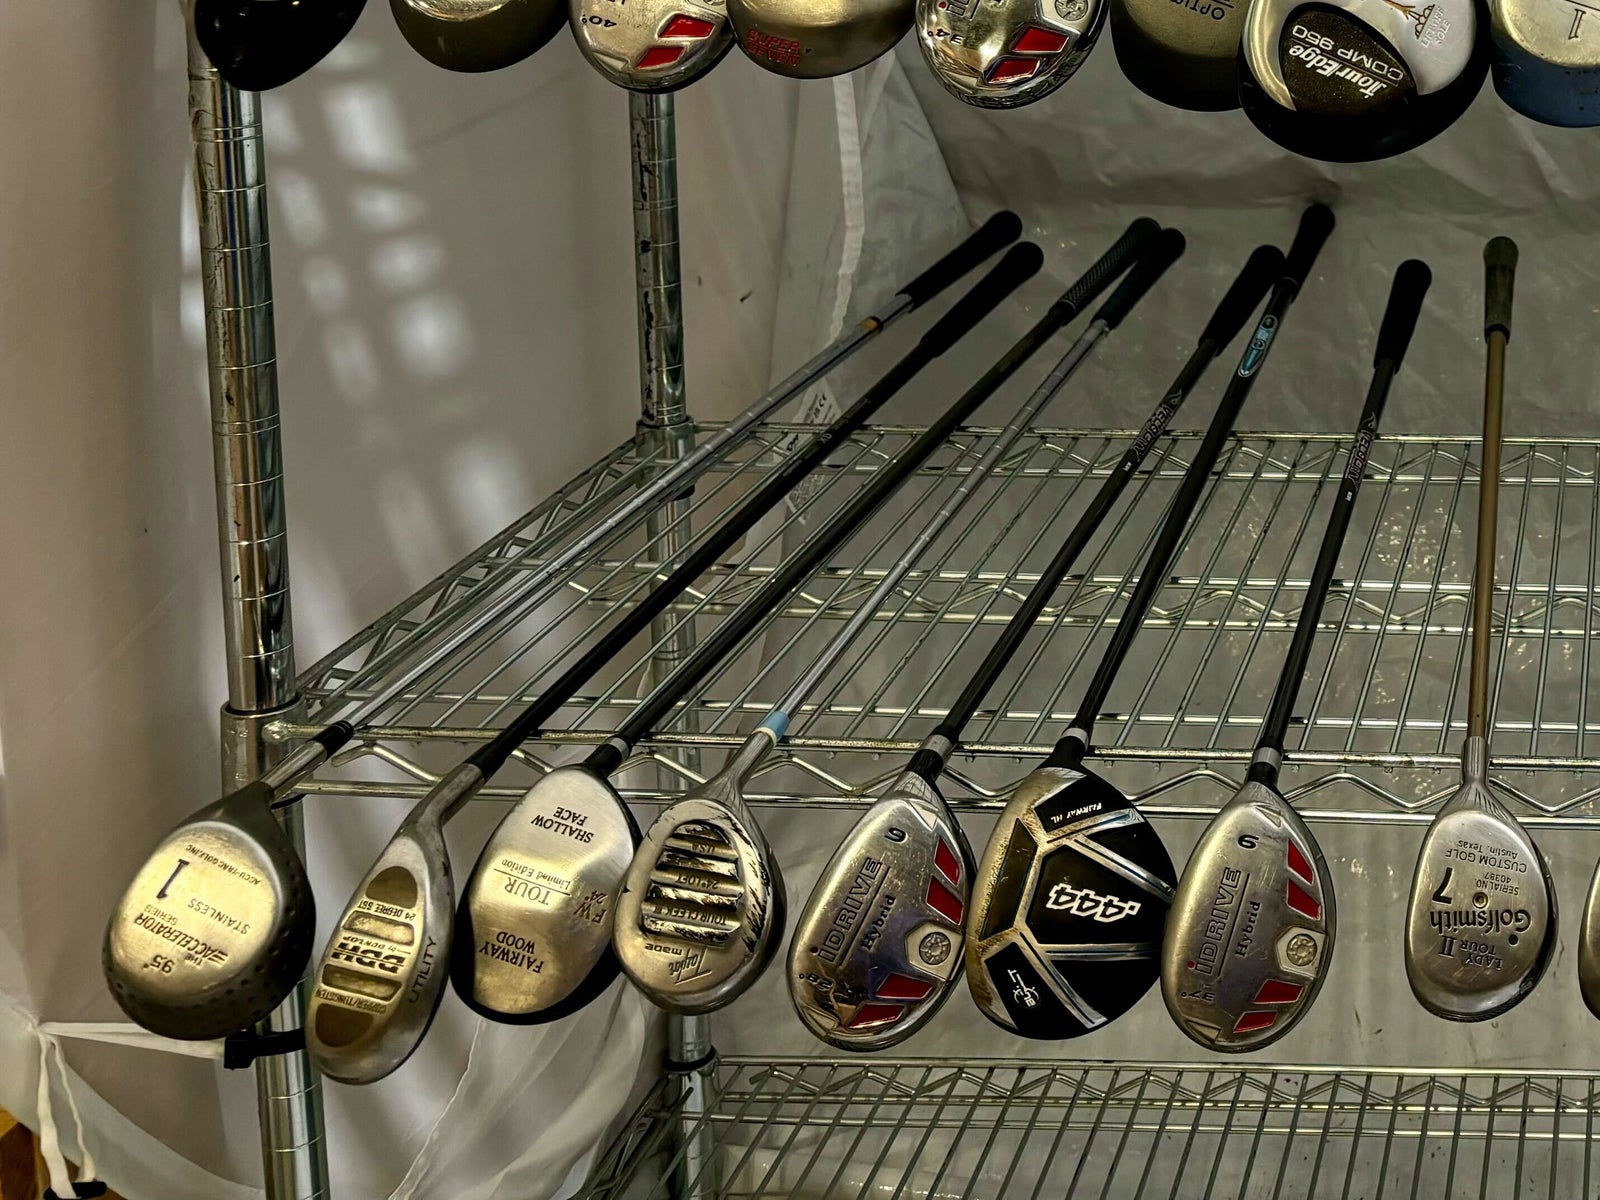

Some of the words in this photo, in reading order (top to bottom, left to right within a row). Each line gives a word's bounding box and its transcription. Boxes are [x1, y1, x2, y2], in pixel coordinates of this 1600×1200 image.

[581, 15, 616, 27] 40°
[1568, 9, 1582, 40] 1
[747, 28, 799, 50] SUPER
[1293, 25, 1336, 50] 950
[747, 40, 800, 66] SEVEN
[1338, 46, 1404, 82] COMP
[553, 807, 588, 826] FACE
[1051, 814, 1063, 823] HL
[1066, 802, 1102, 820] FAIRWAY
[531, 814, 594, 843] SHALLOW
[1445, 848, 1476, 863] GOLF
[1458, 840, 1482, 852] Texas
[501, 858, 534, 877] Edition
[1478, 854, 1527, 873] CUSTOM
[157, 859, 189, 900] 1
[537, 869, 572, 890] Limited
[674, 874, 701, 886] LOFT
[1432, 867, 1453, 904] 7
[1485, 872, 1512, 883] 40387
[503, 876, 551, 905] TOUR
[584, 890, 608, 904] 24°
[144, 904, 178, 926] SERIES
[187, 897, 251, 935] STAINLESS
[375, 904, 404, 919] DEGREE
[405, 912, 416, 922] 24
[669, 907, 700, 922] CLEEK
[700, 910, 727, 925] TOUR
[810, 857, 881, 962] iDRIVE
[1186, 866, 1241, 975] iDRIVE
[861, 896, 896, 950] Hybrid
[1235, 901, 1261, 957] Hybrid
[1430, 910, 1531, 935] Golfsmith
[134, 912, 220, 961] ACCELERATOR
[342, 935, 386, 951] DUNLOP
[496, 931, 535, 953] WOOD
[1439, 936, 1457, 958] II
[1460, 939, 1496, 955] TOUR
[185, 953, 202, 966] THE
[331, 943, 405, 973] DDH
[479, 941, 544, 973] FAIRWAY
[669, 946, 712, 985] Taylor
[1465, 953, 1502, 970] LADY
[410, 936, 436, 1004] UTILITY
[1181, 991, 1216, 1001] 37°
